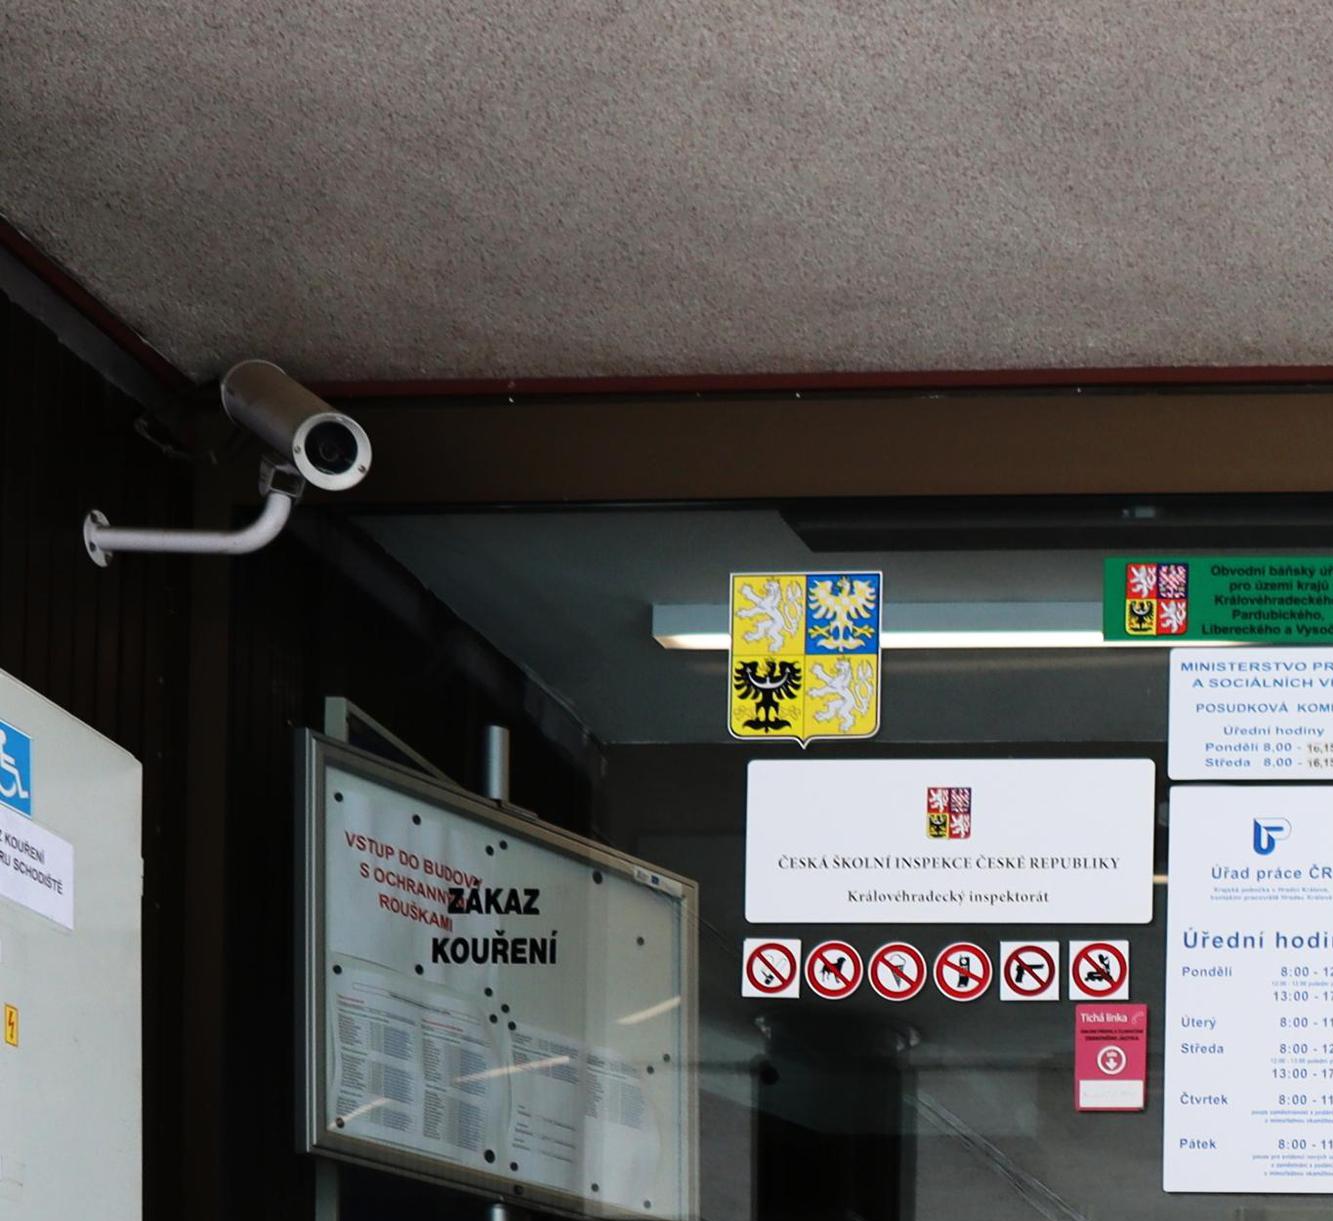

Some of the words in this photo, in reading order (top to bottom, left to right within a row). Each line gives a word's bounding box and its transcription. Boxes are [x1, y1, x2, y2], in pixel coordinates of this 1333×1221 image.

[1211, 565, 1265, 576] Obvodní
[1230, 582, 1250, 592] pro
[1255, 580, 1292, 591] území
[1297, 580, 1329, 592] krajů
[1202, 624, 1280, 635] Libereckého
[1285, 627, 1292, 635] a
[1181, 662, 1307, 671] MINISTERSTVO
[1192, 678, 1204, 688] A
[1209, 677, 1312, 688] SOCIÁLNÍCH
[1196, 702, 1288, 713] POSUDKOVÁ
[1224, 725, 1270, 736] Úřední
[1275, 726, 1324, 737] hodiny
[1205, 742, 1258, 752] Pondělí
[1205, 757, 1250, 767] Středa
[345, 830, 394, 860] VSTUP
[399, 849, 419, 870] DO
[778, 854, 829, 870] ČESKÁ
[833, 854, 892, 870] ŠKOLNÍ
[895, 857, 973, 870] INSPEKCE
[976, 854, 1026, 870] ČESKÉ
[1030, 857, 1120, 870] REPUBLIKY
[1212, 865, 1249, 879] Úřad
[1257, 868, 1302, 882] práce
[1309, 864, 1332, 879] ČR
[360, 863, 369, 879] S
[375, 868, 465, 909] OCHRANN
[448, 877, 540, 915] ZÁKAZ
[848, 890, 965, 905] Královéhradecký
[969, 890, 1049, 905] inspektorát
[378, 894, 452, 932] ROUŠKAMI
[1183, 928, 1264, 949] Úřední
[432, 930, 558, 964] KOUŘENÍ
[1182, 966, 1232, 977] Pondělí
[1281, 967, 1309, 977] 8:00
[1273, 991, 1309, 1001] 13:00
[1081, 1012, 1104, 1023] Tichá
[1106, 1013, 1127, 1023] linka
[1181, 1015, 1216, 1030] Úterý
[1280, 1017, 1308, 1027] 8:00
[1181, 1043, 1224, 1054] Středa
[1280, 1044, 1308, 1054] 8:00
[1272, 1069, 1308, 1079] 13:00
[1180, 1092, 1228, 1105] Čtvrtek
[1279, 1095, 1307, 1105] 8:00
[1180, 1138, 1216, 1149] Pátek
[1278, 1139, 1307, 1149] 8:00
